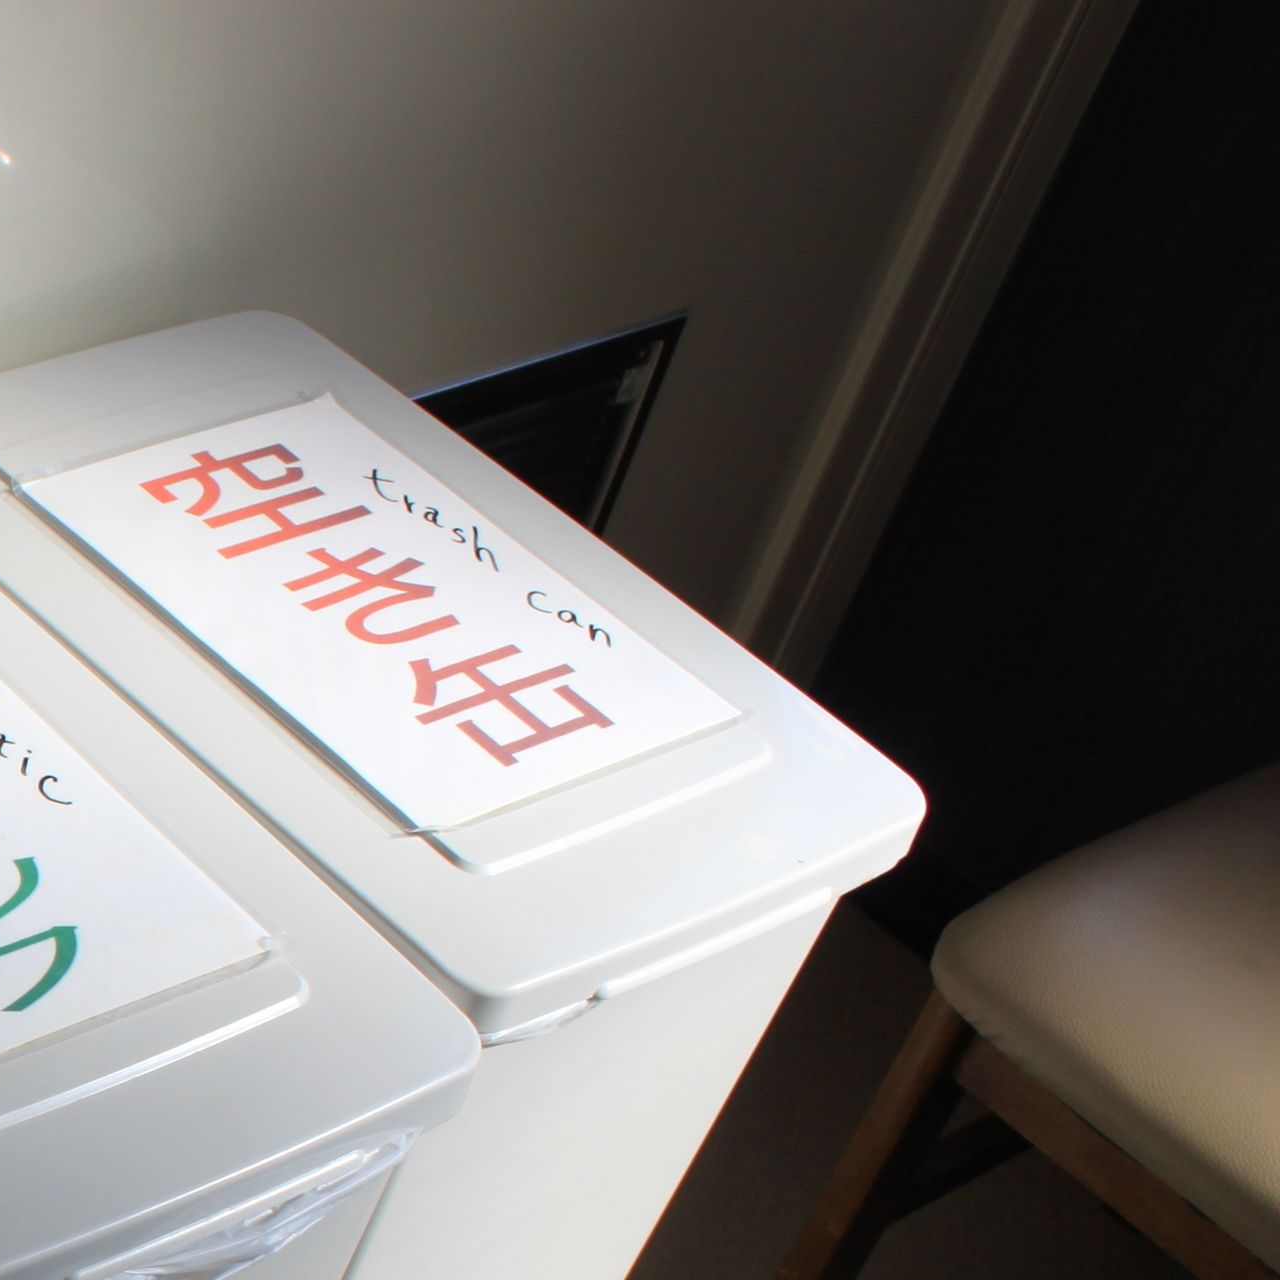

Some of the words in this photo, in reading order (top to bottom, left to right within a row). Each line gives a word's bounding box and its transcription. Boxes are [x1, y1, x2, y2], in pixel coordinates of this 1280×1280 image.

[140, 443, 615, 767] 空き缶
[362, 468, 500, 573] trash
[526, 591, 612, 648] can
